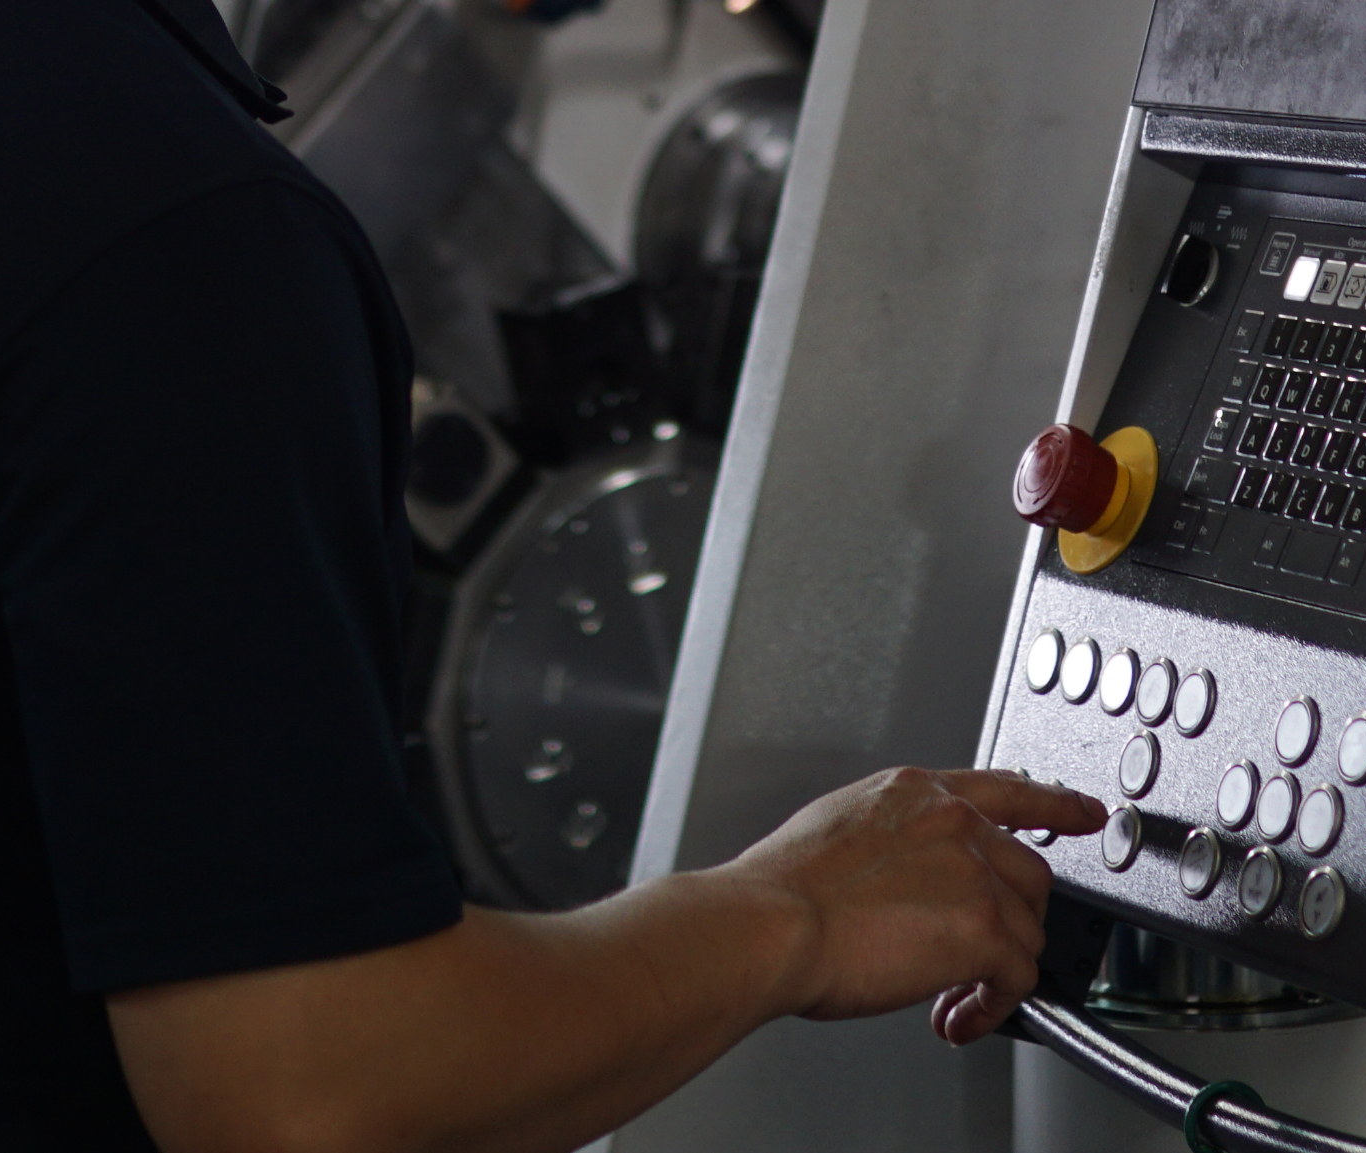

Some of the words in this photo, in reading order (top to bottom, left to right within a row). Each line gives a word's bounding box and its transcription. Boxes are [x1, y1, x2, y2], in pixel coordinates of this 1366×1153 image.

[1237, 326, 1248, 337] Esc
[1274, 335, 1282, 348] 1
[1299, 340, 1308, 354] 2
[1327, 344, 1336, 357] 3
[1355, 349, 1363, 364] 4
[1260, 384, 1270, 398] Q
[1286, 389, 1298, 403] W
[1314, 394, 1323, 408] E
[1342, 399, 1351, 413] R
[1247, 434, 1256, 448] A
[1274, 439, 1284, 453] S
[1301, 444, 1311, 458] D
[1329, 449, 1339, 463] F
[1357, 455, 1366, 469] G
[1242, 486, 1252, 499] Z
[1269, 490, 1278, 505] X
[1296, 497, 1306, 511] C
[1324, 502, 1334, 516] V
[1352, 508, 1361, 522] B
